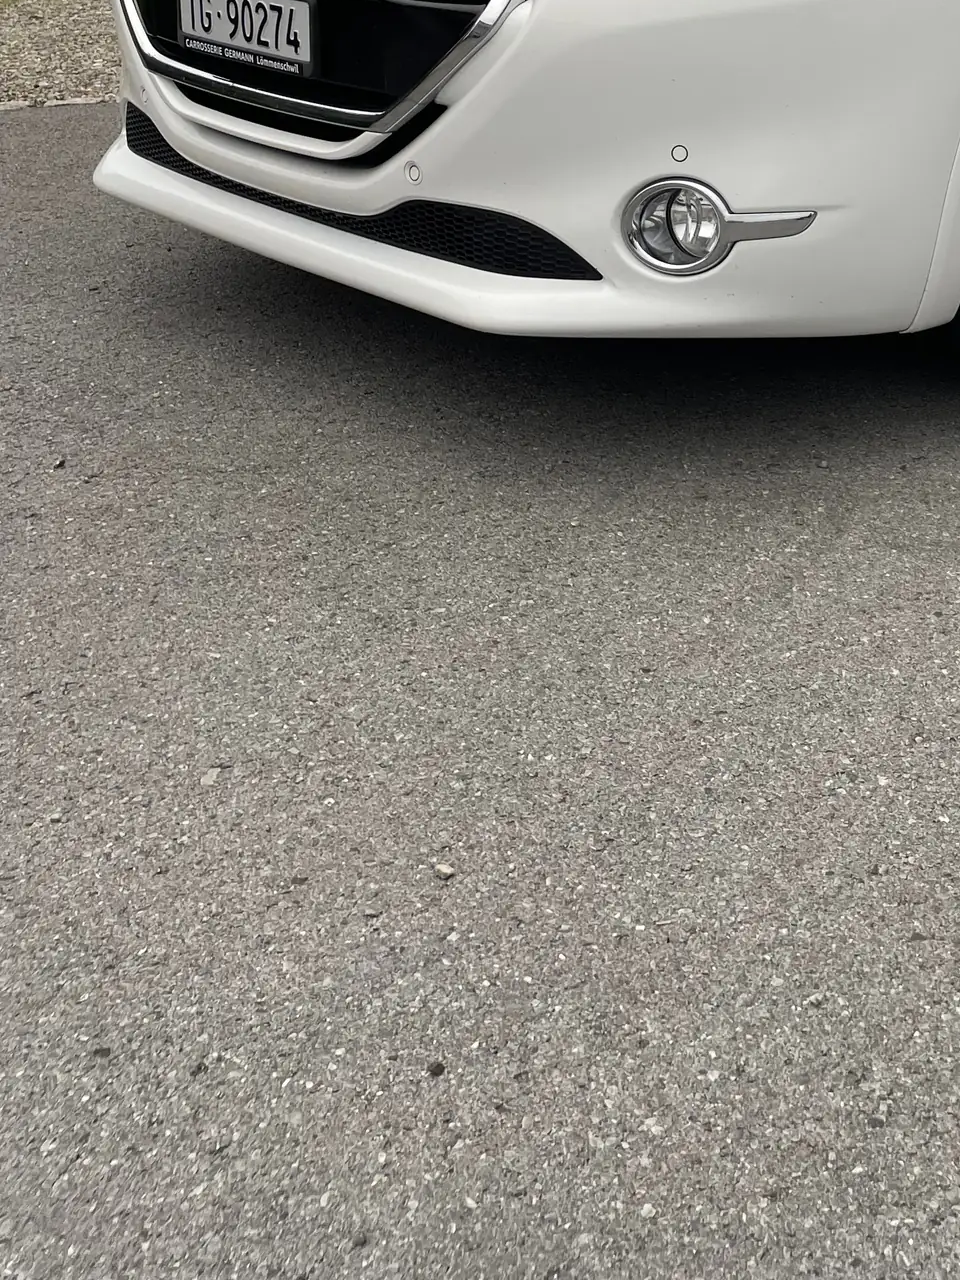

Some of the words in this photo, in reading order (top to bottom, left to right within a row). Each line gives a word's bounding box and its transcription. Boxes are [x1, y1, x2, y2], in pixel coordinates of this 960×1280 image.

[185, 38, 223, 56] CARROSSERIE
[224, 48, 254, 63] GERMANN
[256, 55, 299, 74] Lömmenschwil
